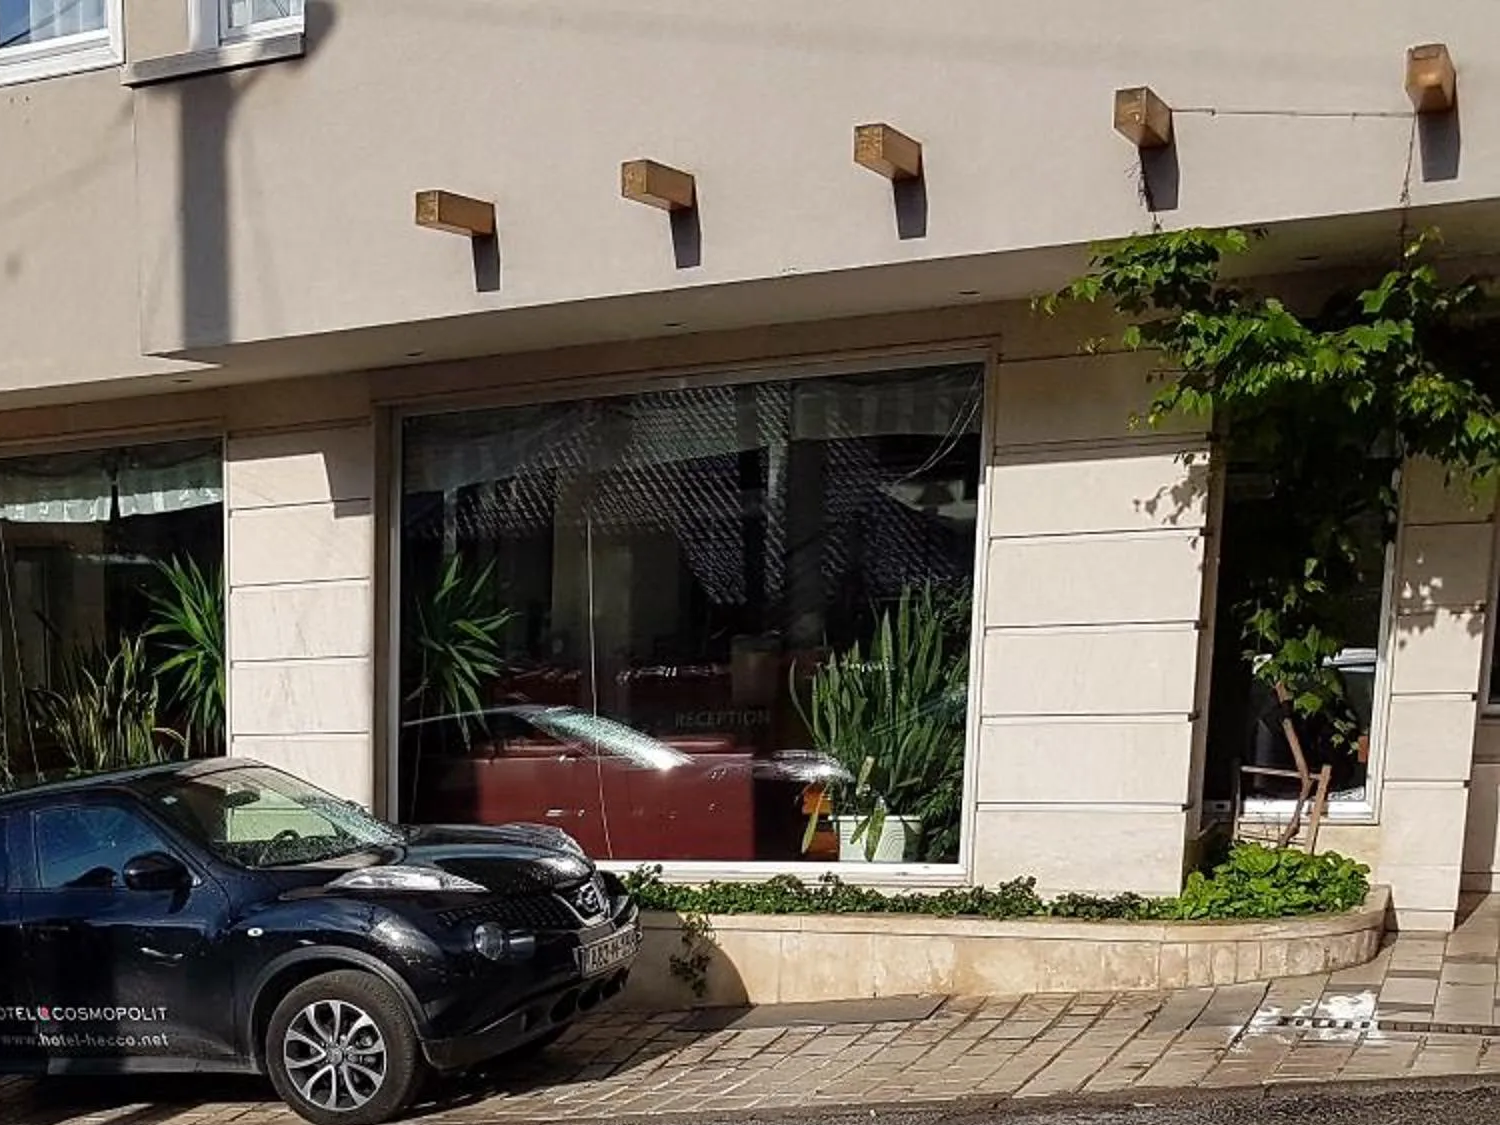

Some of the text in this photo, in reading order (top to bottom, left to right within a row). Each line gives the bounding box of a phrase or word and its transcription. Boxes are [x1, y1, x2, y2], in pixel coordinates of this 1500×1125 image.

[674, 709, 771, 728] RECEPTION
[51, 1006, 168, 1022] COSMOPOLIT
[0, 1032, 170, 1048] www.hotel-hecco.net
